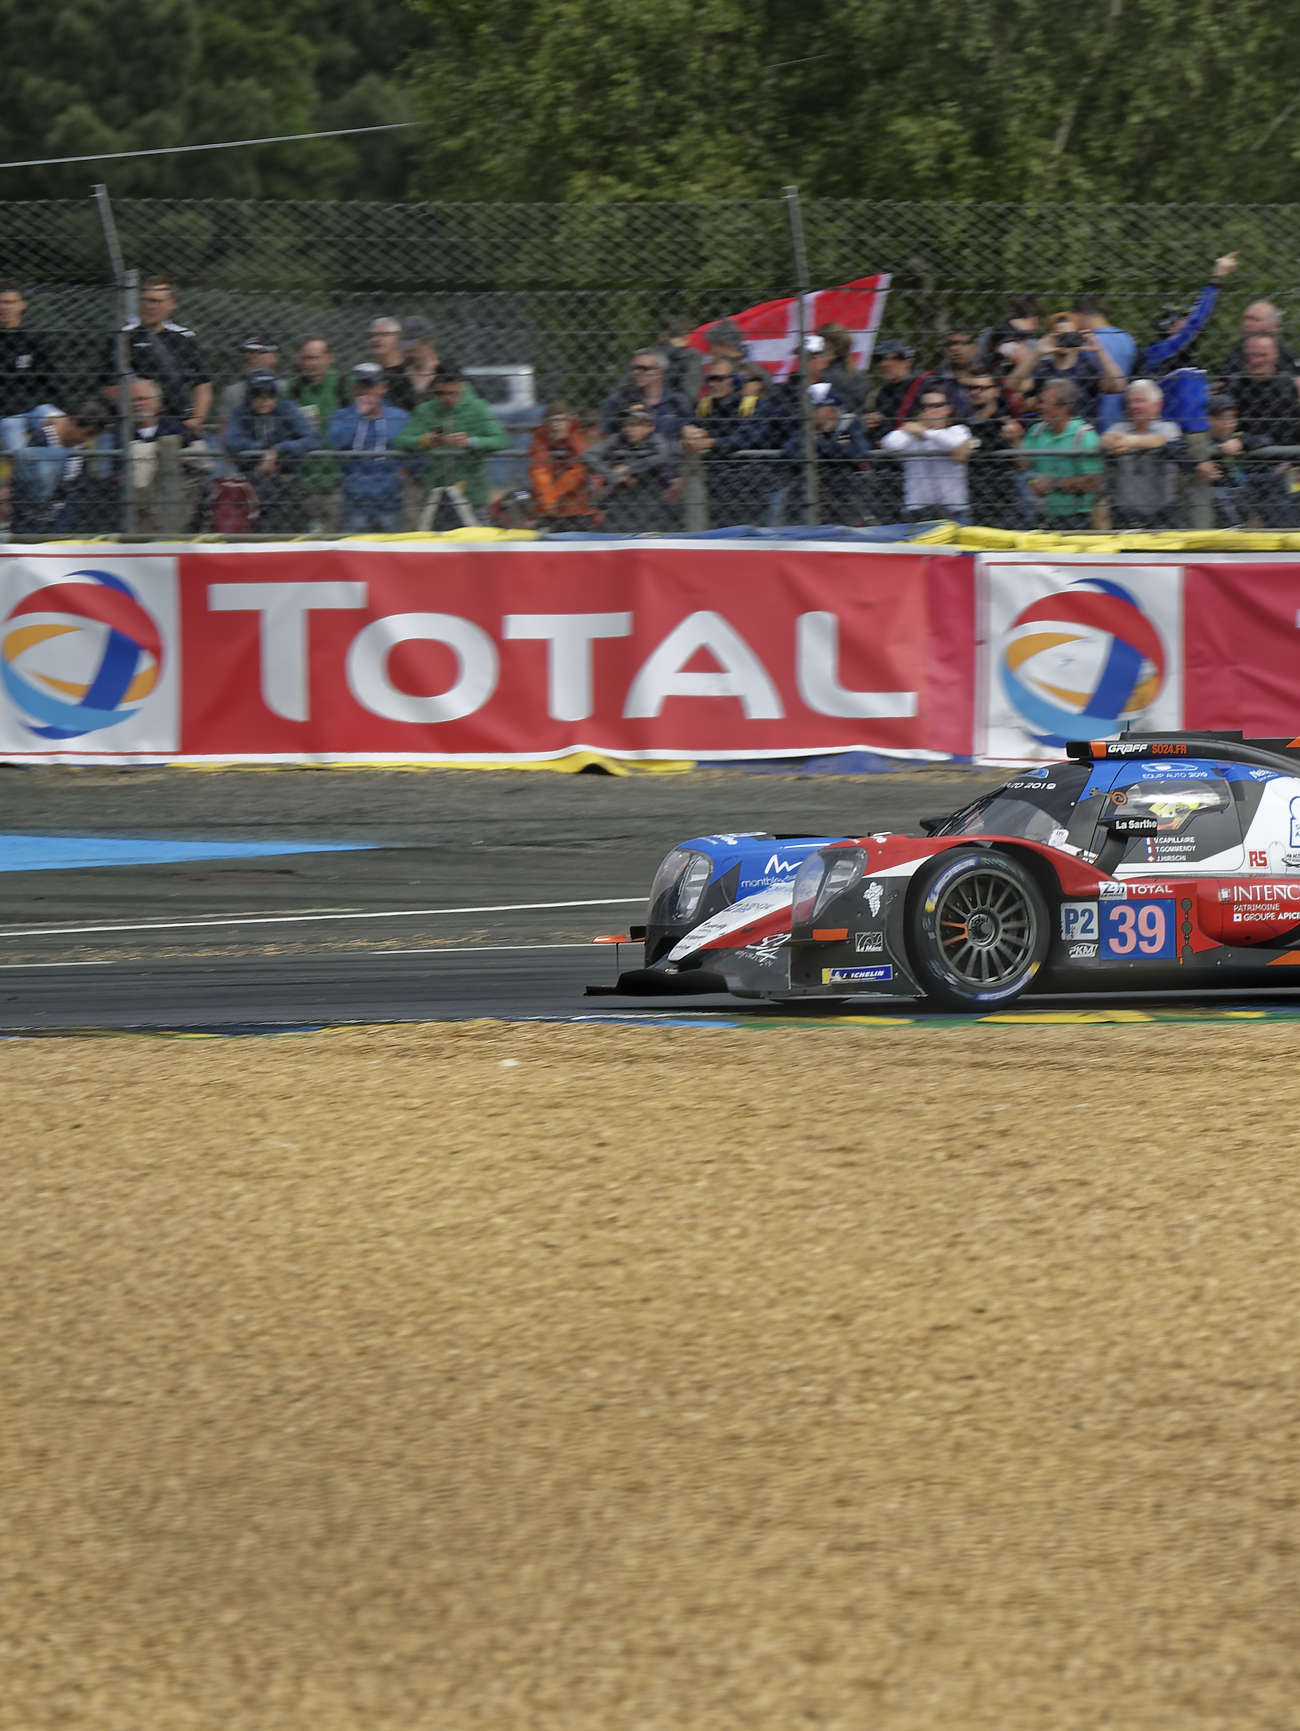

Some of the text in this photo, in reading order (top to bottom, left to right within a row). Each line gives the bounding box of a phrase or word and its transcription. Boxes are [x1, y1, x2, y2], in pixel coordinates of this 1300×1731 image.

[209, 582, 917, 723] TOTAL
[1108, 744, 1148, 754] GRAFF
[1115, 820, 1127, 830] La
[1248, 851, 1268, 867] RS
[1128, 884, 1174, 895] TOTAL
[1243, 913, 1276, 921] GROUPE
[1064, 905, 1166, 954] P2 39
